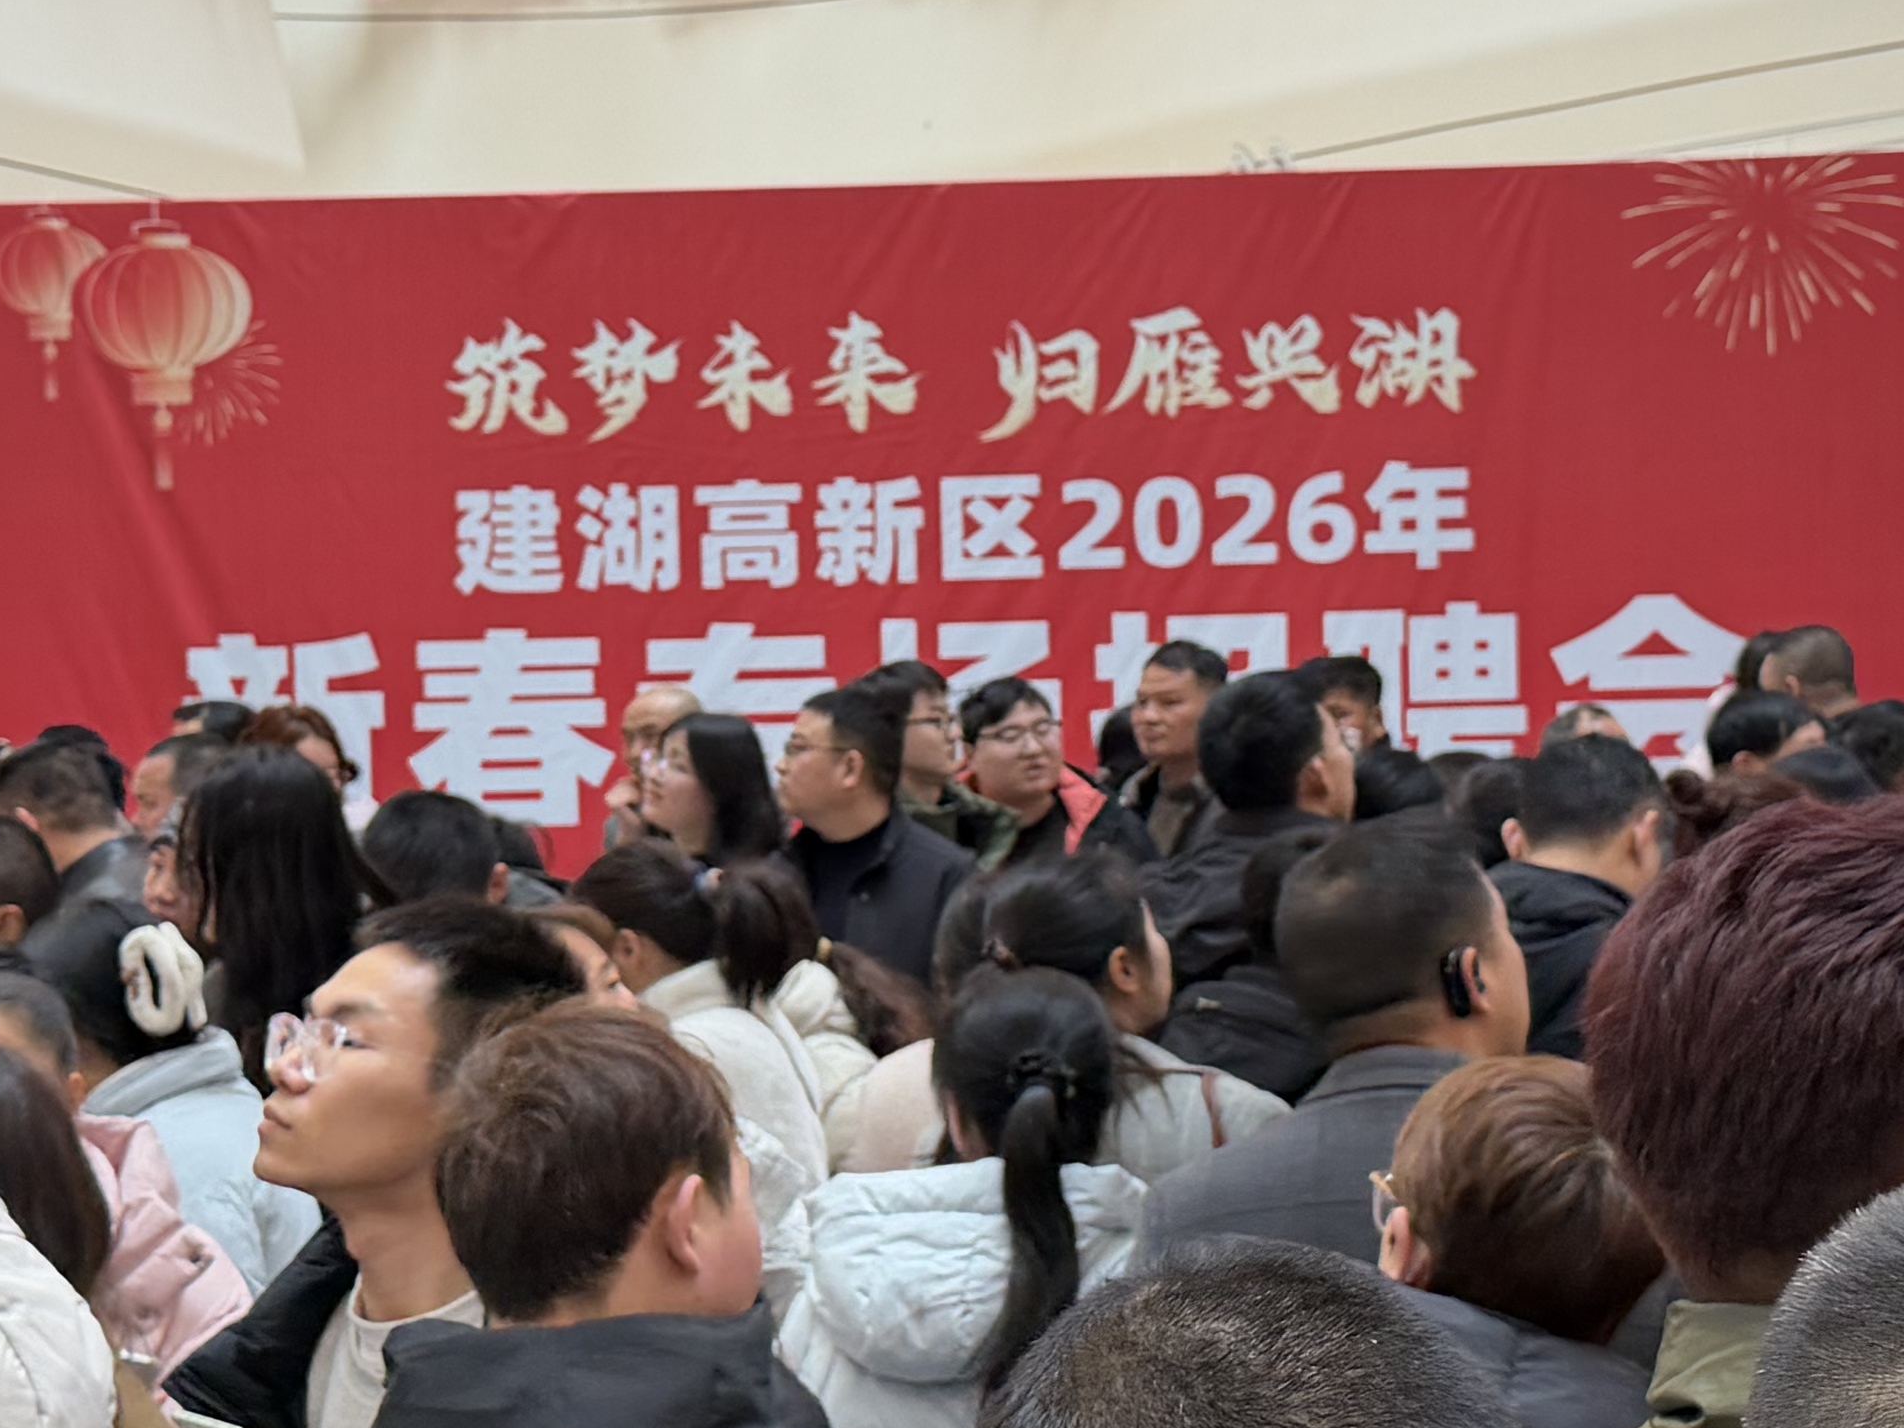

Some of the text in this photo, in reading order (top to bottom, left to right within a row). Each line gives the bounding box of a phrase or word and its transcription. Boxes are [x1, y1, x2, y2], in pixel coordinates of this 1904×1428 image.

[446, 310, 925, 444] 筑梦未来
[453, 459, 1475, 595] 建湖高新区2026年
